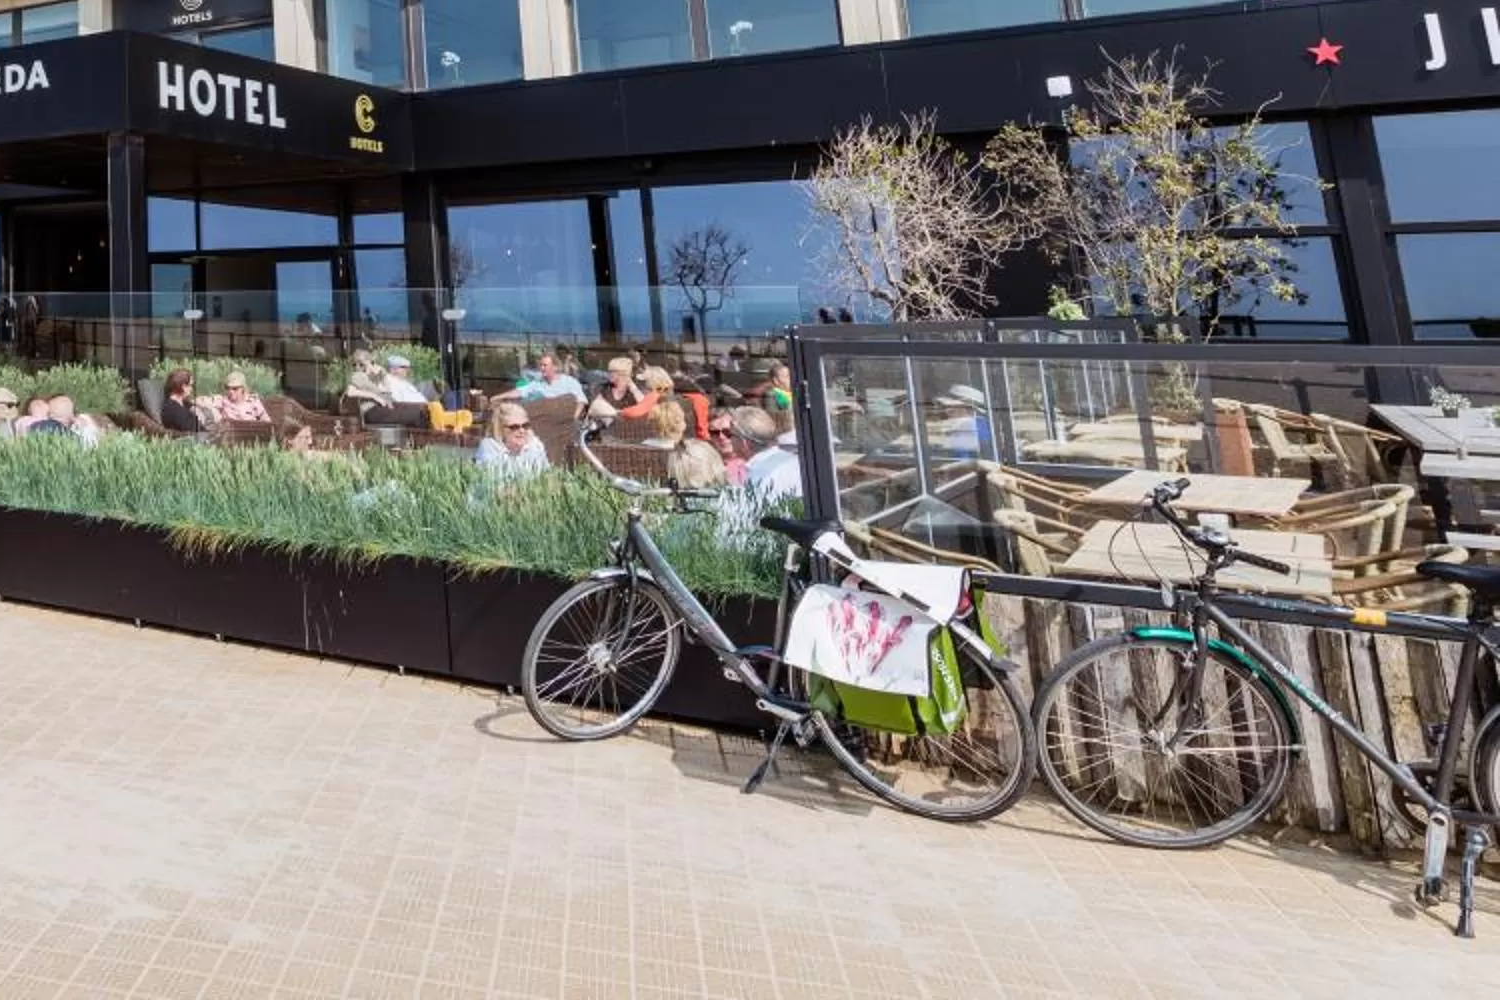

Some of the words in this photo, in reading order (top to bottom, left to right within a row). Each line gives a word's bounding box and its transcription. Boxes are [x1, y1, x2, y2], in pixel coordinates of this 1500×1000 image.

[171, 9, 213, 25] HOTELS
[158, 60, 287, 129] HOTEL
[350, 136, 383, 153] HOTELS
